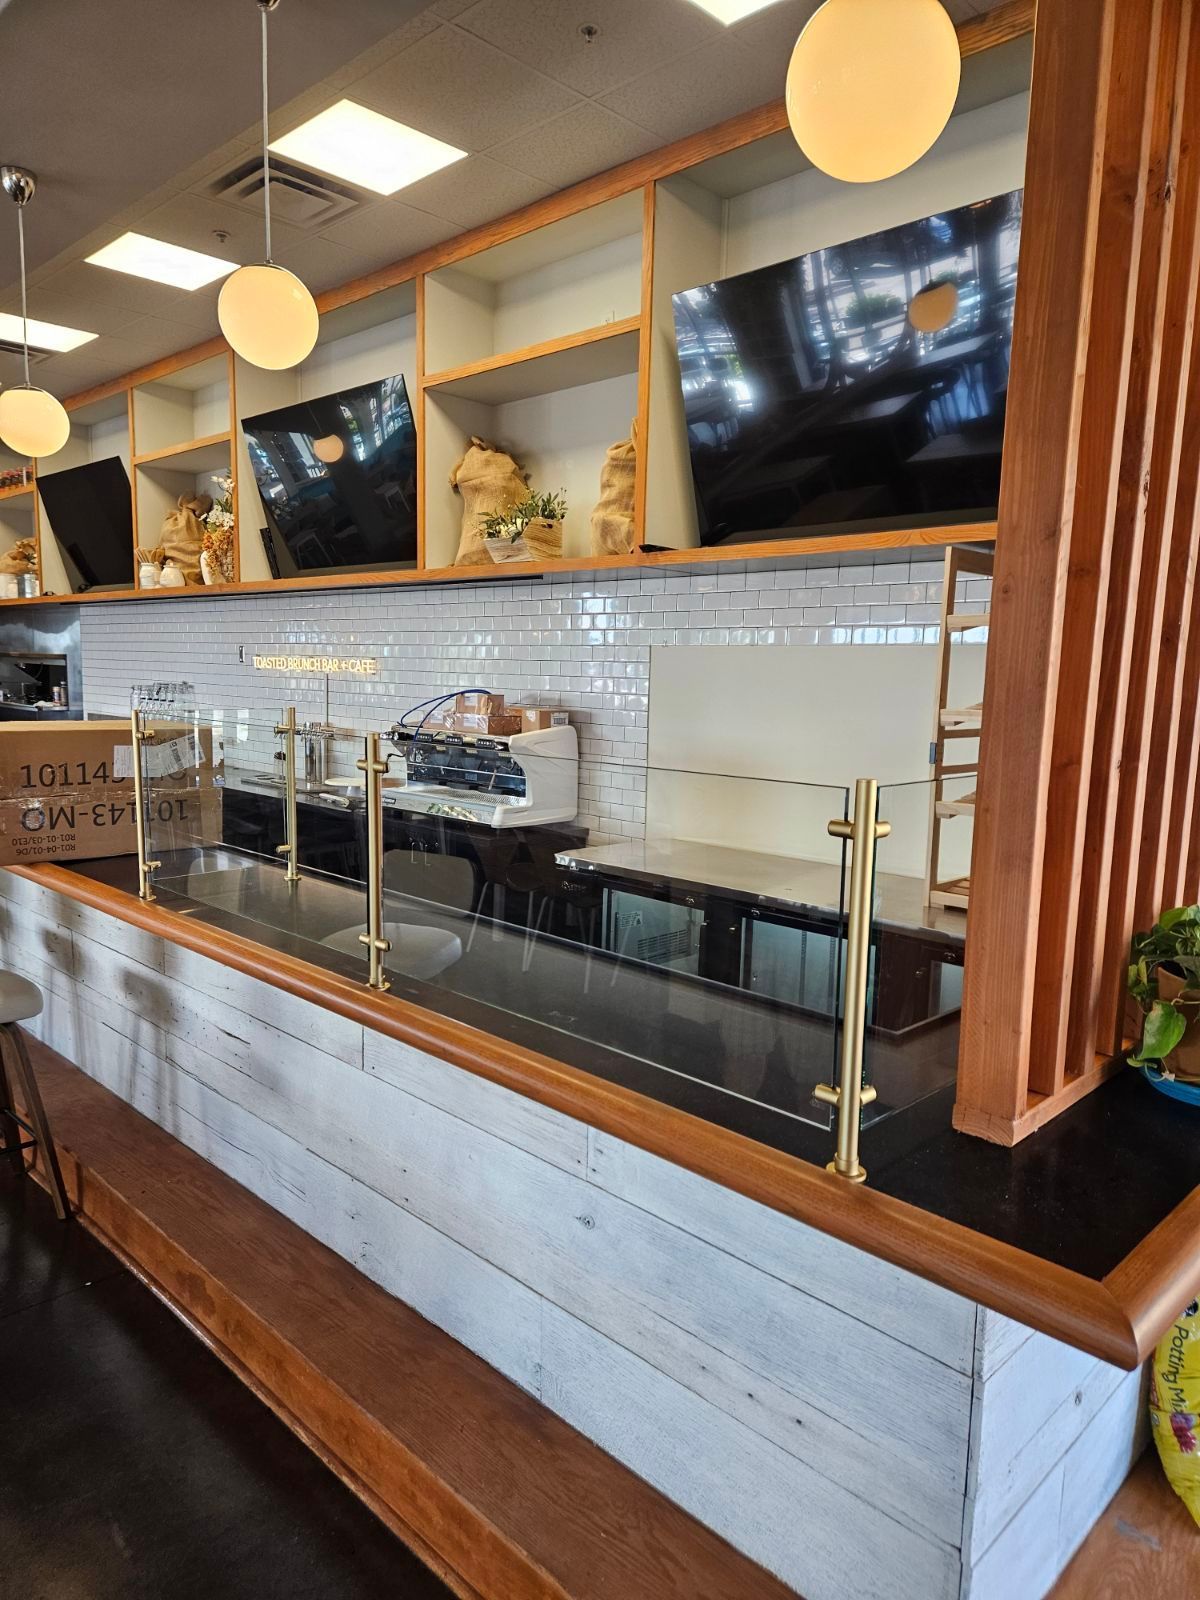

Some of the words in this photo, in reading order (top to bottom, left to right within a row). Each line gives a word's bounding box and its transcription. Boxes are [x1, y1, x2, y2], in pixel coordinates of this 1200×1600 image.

[252, 656, 287, 670] TOASTED
[288, 656, 322, 672] BRUNCH
[323, 658, 338, 673] BAR
[1161, 1324, 1190, 1384] Potting
